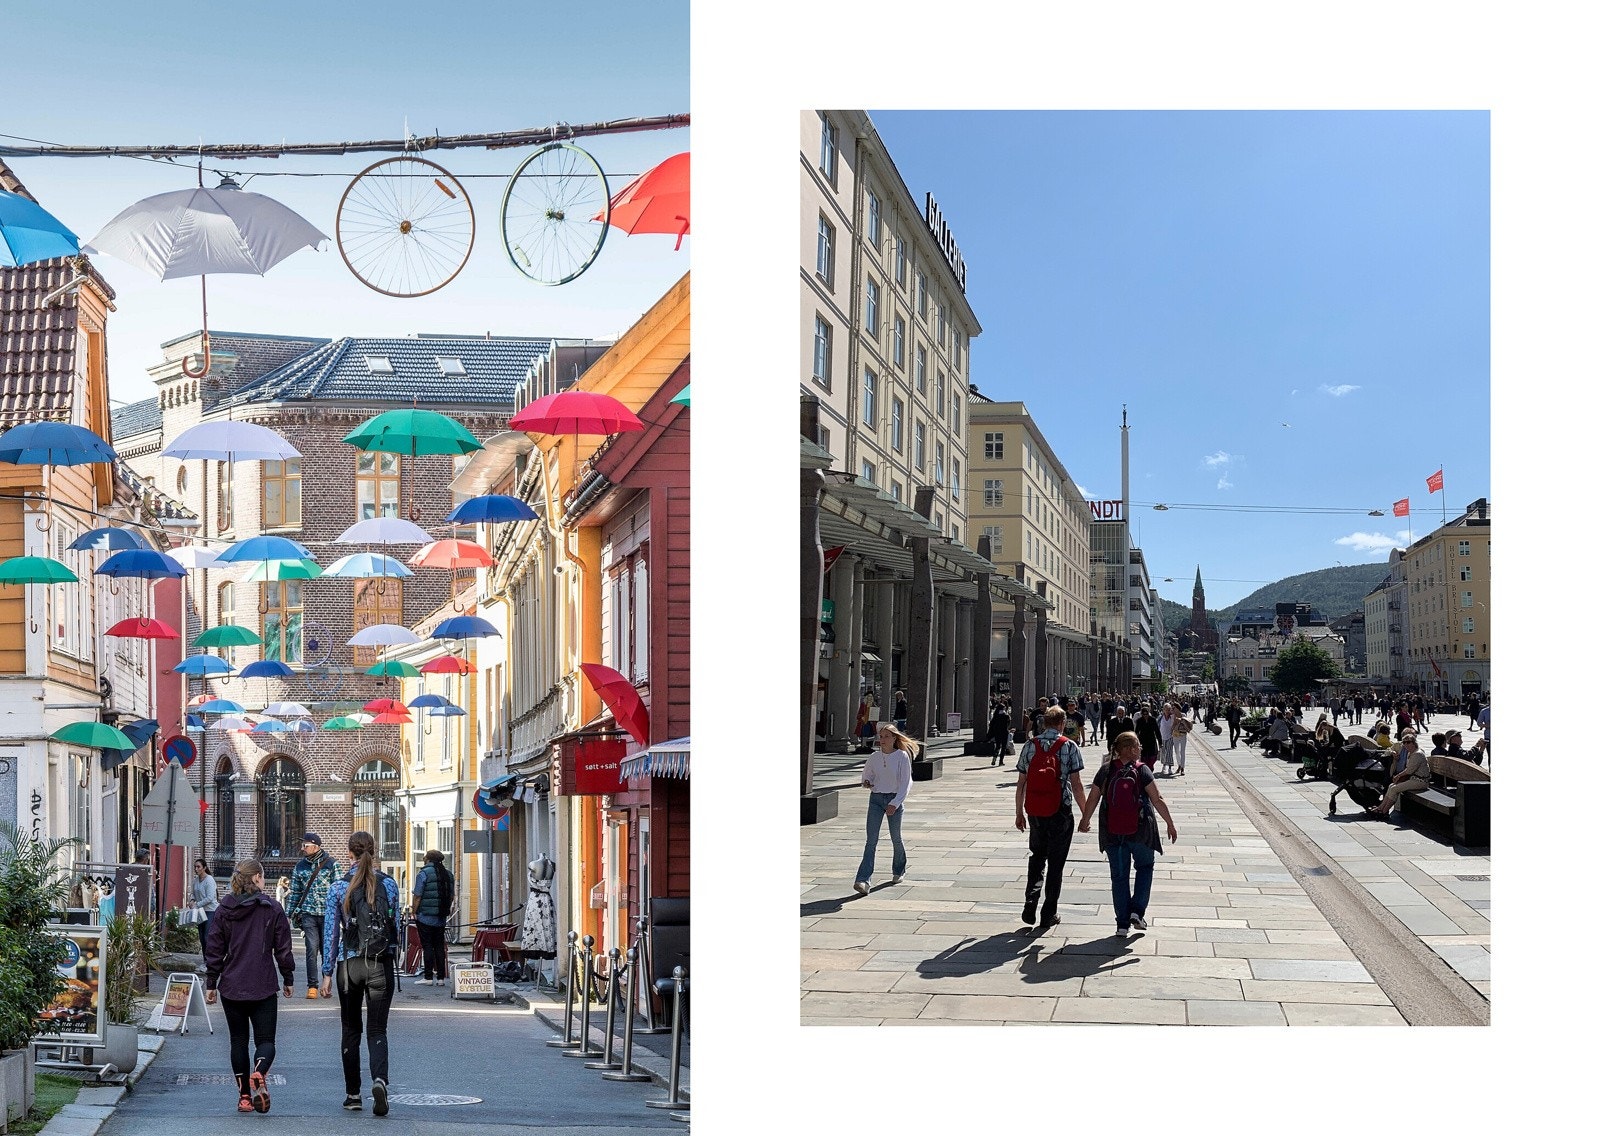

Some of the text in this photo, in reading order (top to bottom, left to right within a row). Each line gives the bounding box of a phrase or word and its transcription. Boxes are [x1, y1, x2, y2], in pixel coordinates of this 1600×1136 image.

[926, 192, 967, 294] GALLERIET
[1087, 501, 1123, 518] NDT
[1451, 585, 1459, 633] BRISTOL
[457, 977, 492, 985] VINTAGE
